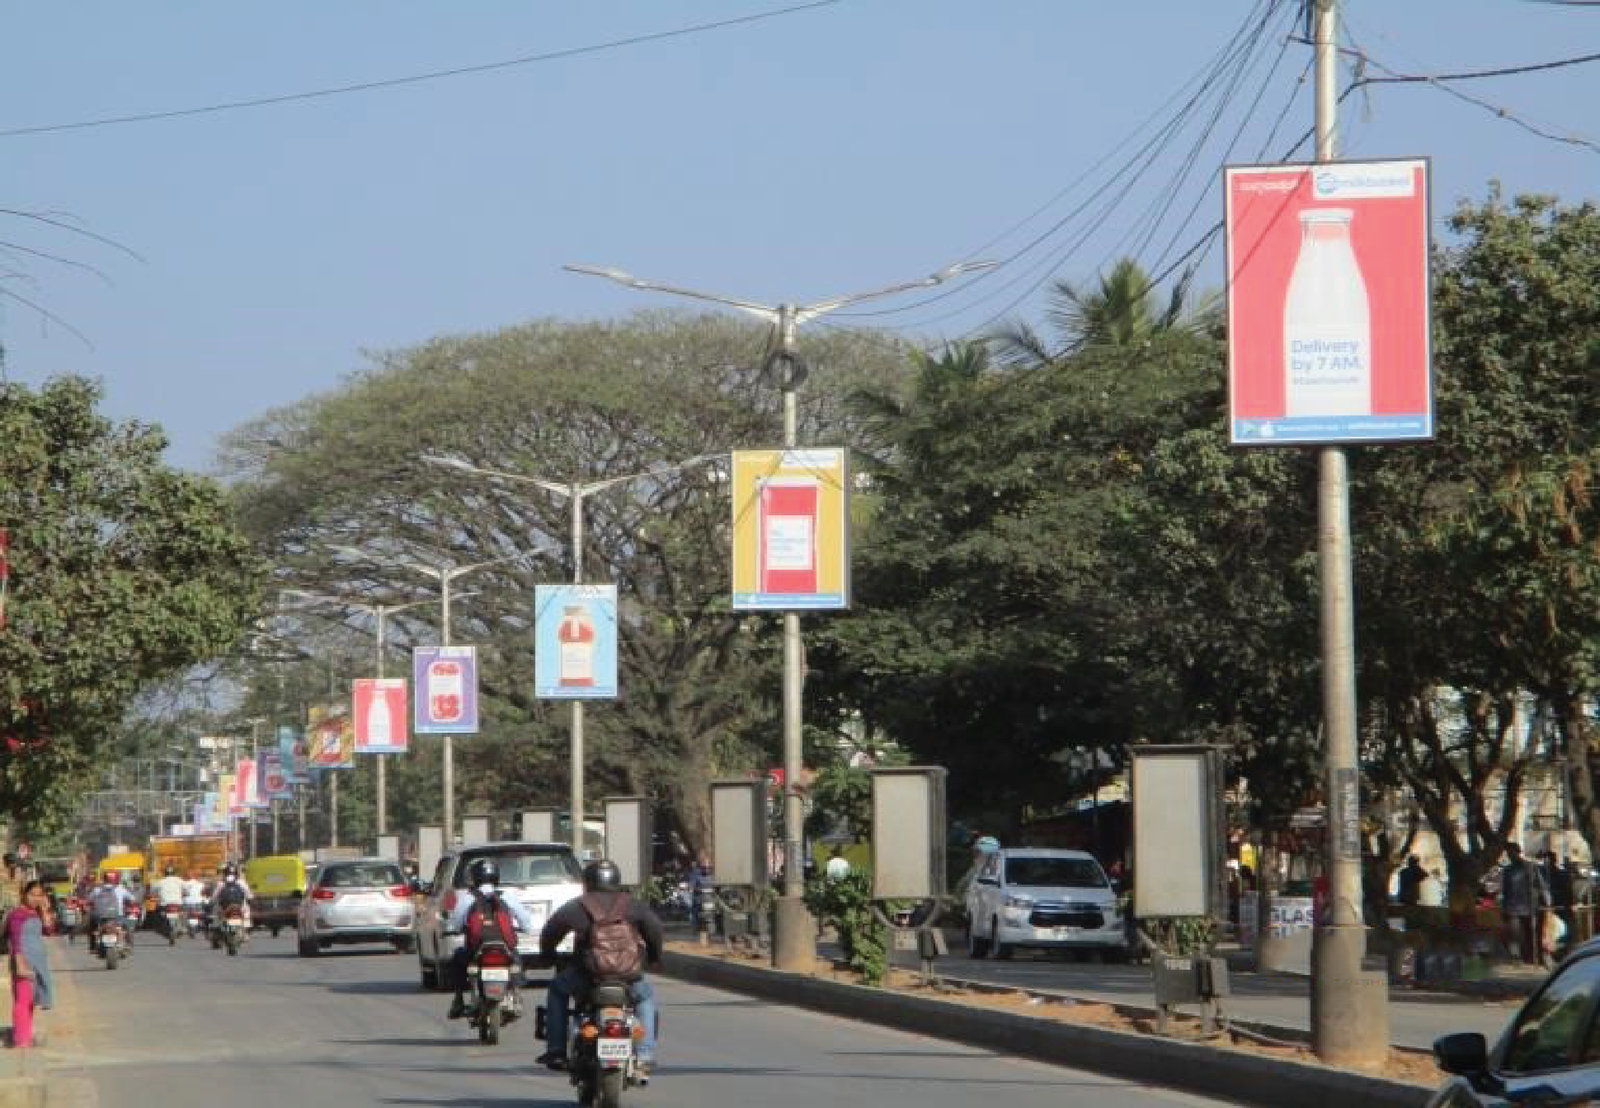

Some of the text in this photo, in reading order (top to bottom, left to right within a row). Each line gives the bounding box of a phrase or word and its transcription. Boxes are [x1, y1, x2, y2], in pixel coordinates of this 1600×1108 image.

[1291, 339, 1358, 356] Delivery
[1291, 356, 1312, 374] by
[1316, 357, 1327, 370] 7
